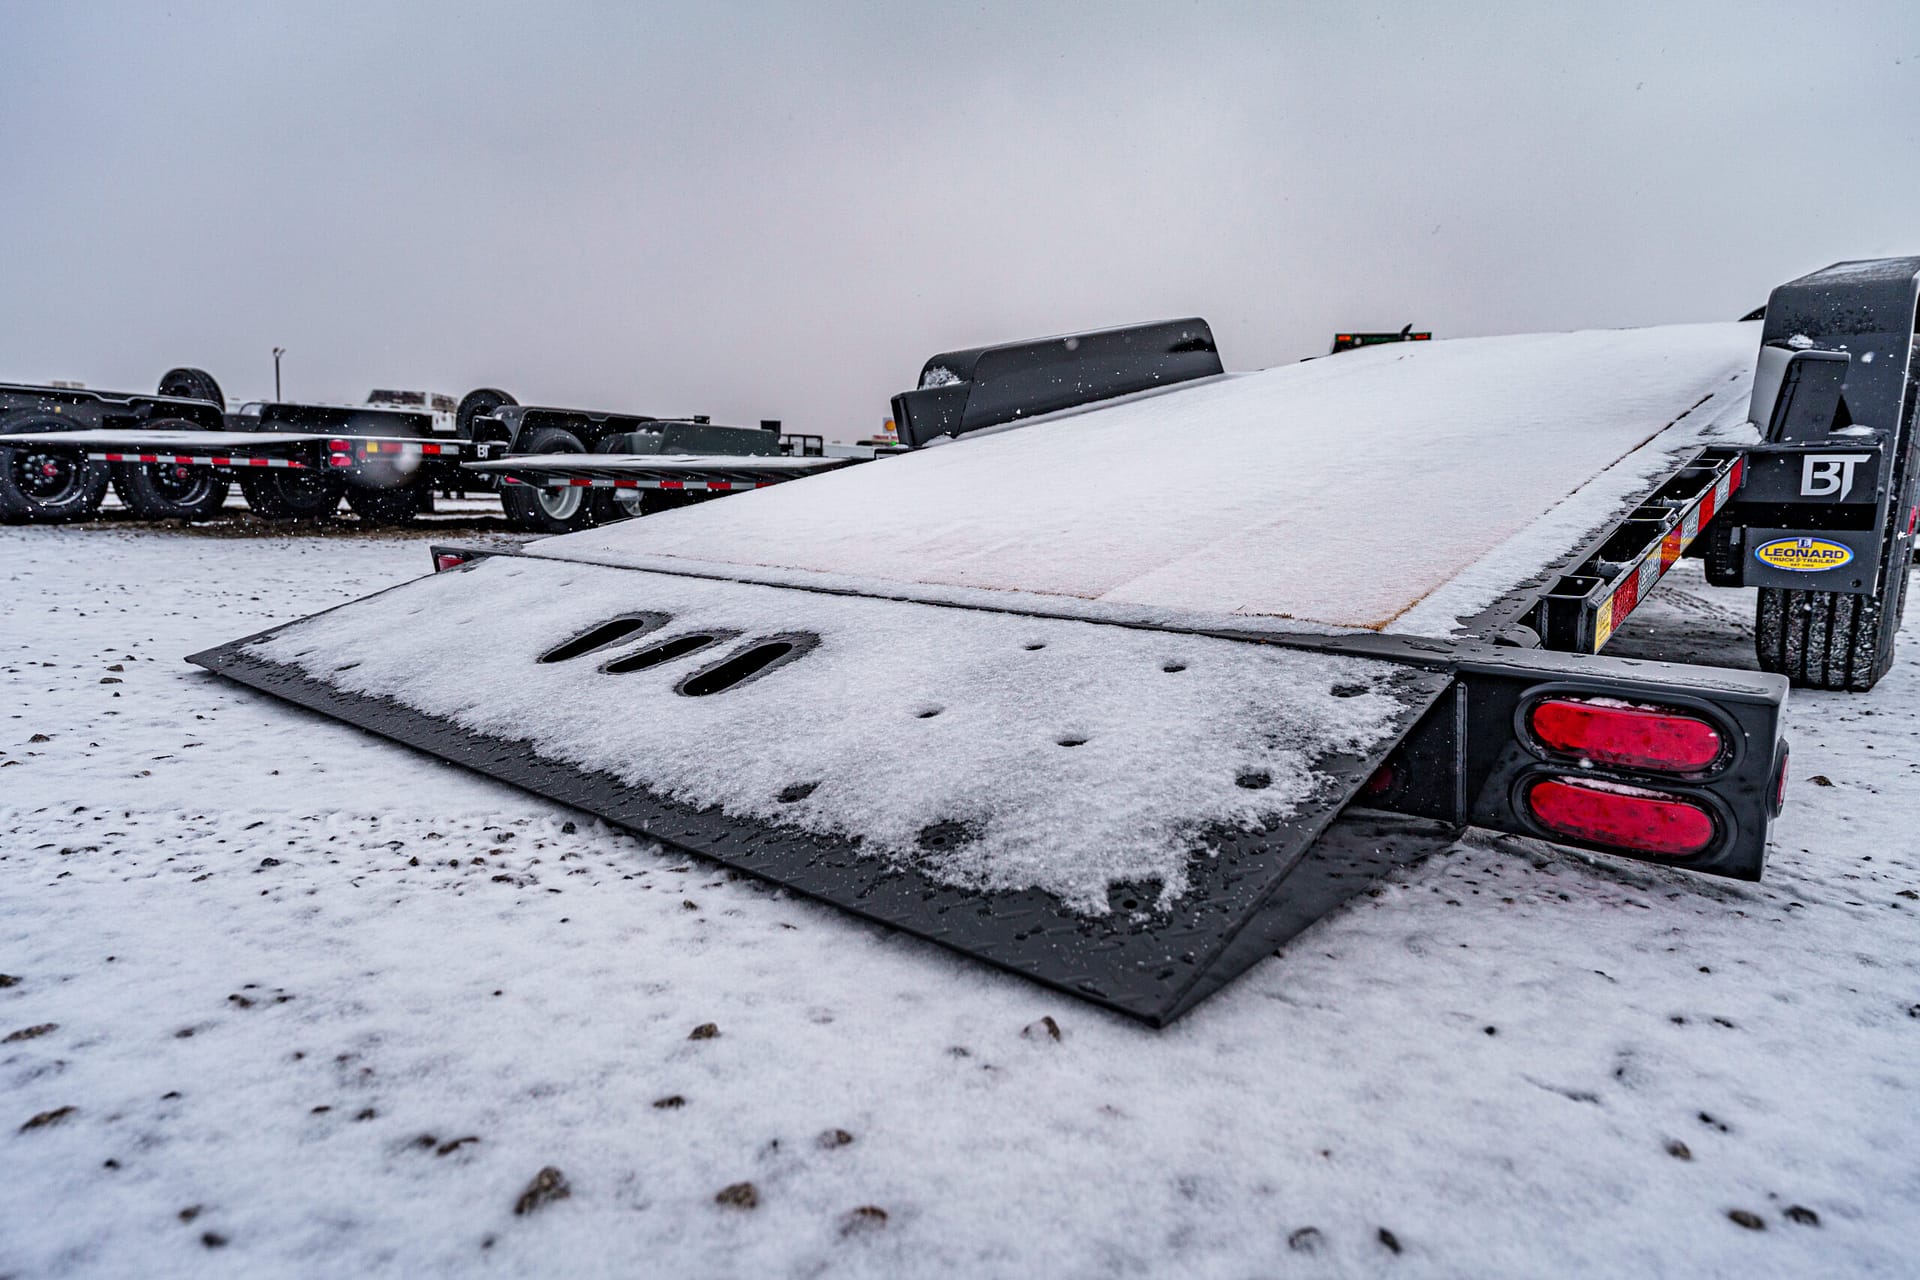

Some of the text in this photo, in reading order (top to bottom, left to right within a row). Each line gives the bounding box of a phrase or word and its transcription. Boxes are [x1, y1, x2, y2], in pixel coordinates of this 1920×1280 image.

[477, 444, 490, 460] BT
[1800, 454, 1872, 503] BT
[1764, 548, 1844, 559] LEONARD
